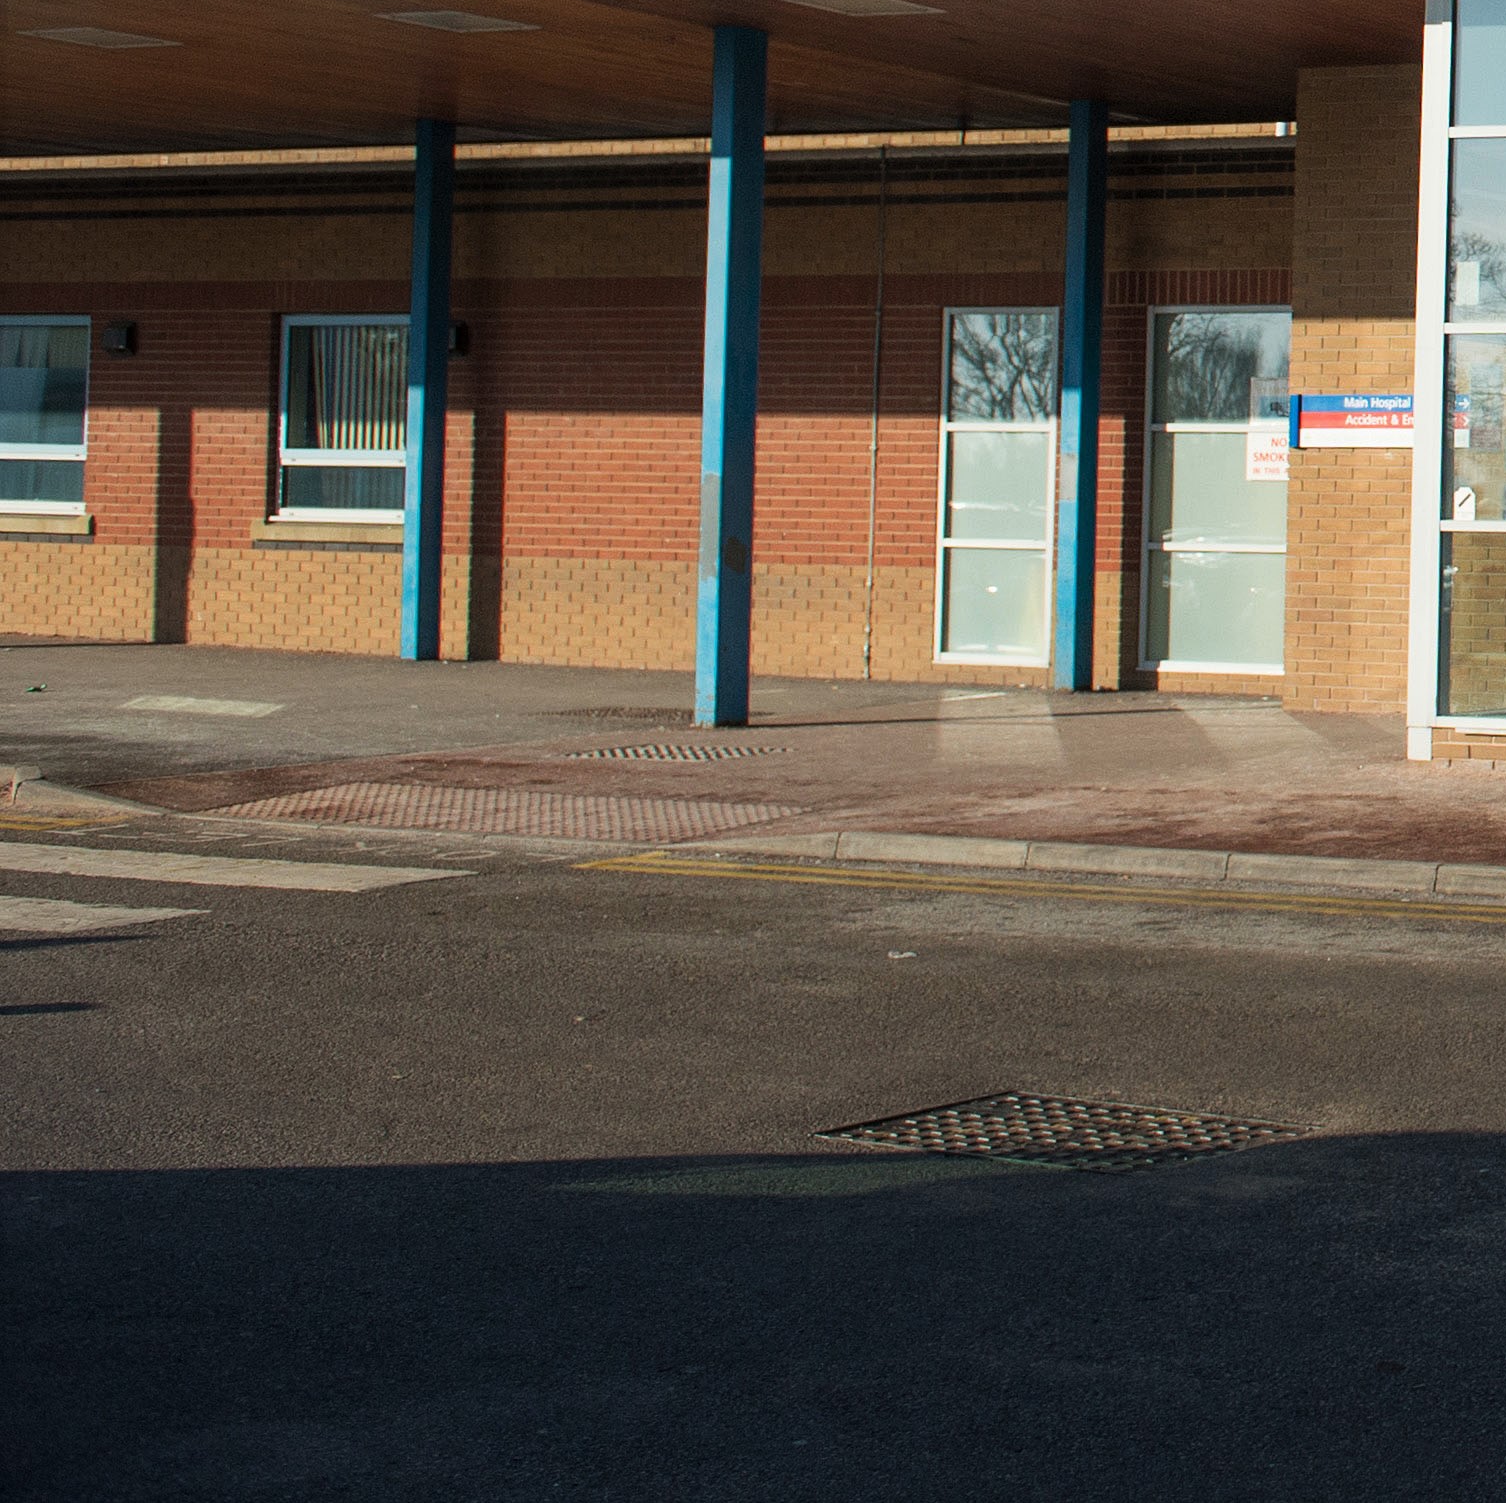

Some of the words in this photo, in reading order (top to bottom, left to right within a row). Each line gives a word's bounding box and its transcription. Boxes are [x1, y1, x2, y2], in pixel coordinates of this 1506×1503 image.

[1344, 397, 1369, 408] Main
[1370, 396, 1411, 411] Hospital
[1345, 413, 1388, 426] Accident
[1390, 413, 1399, 426] &
[1271, 437, 1288, 447] NO
